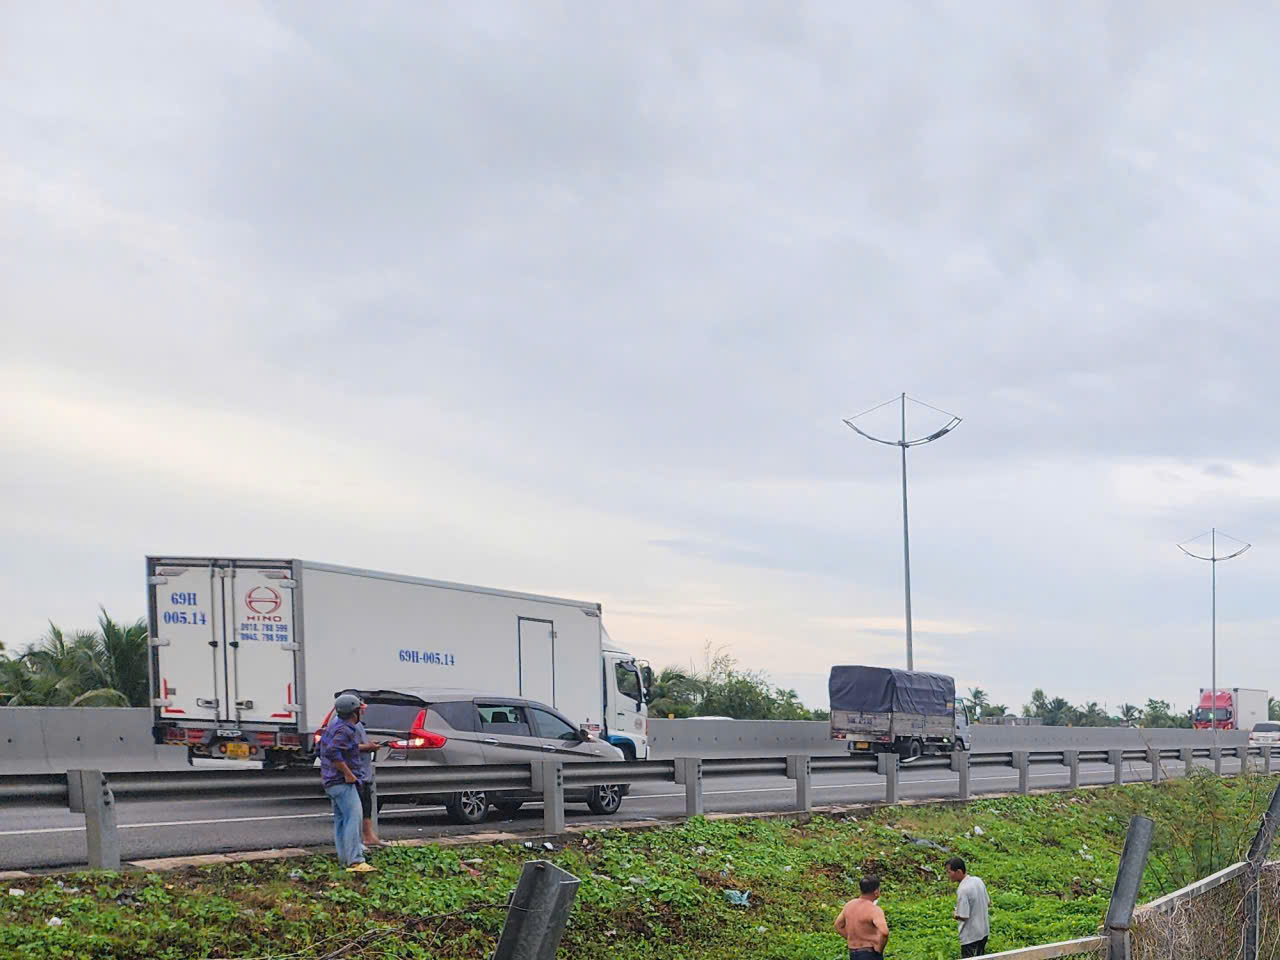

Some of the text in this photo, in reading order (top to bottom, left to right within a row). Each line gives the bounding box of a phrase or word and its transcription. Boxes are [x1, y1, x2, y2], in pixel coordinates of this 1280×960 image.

[171, 592, 197, 605] 69H
[163, 611, 207, 625] 005.14
[399, 649, 455, 666] 69H-005.14
